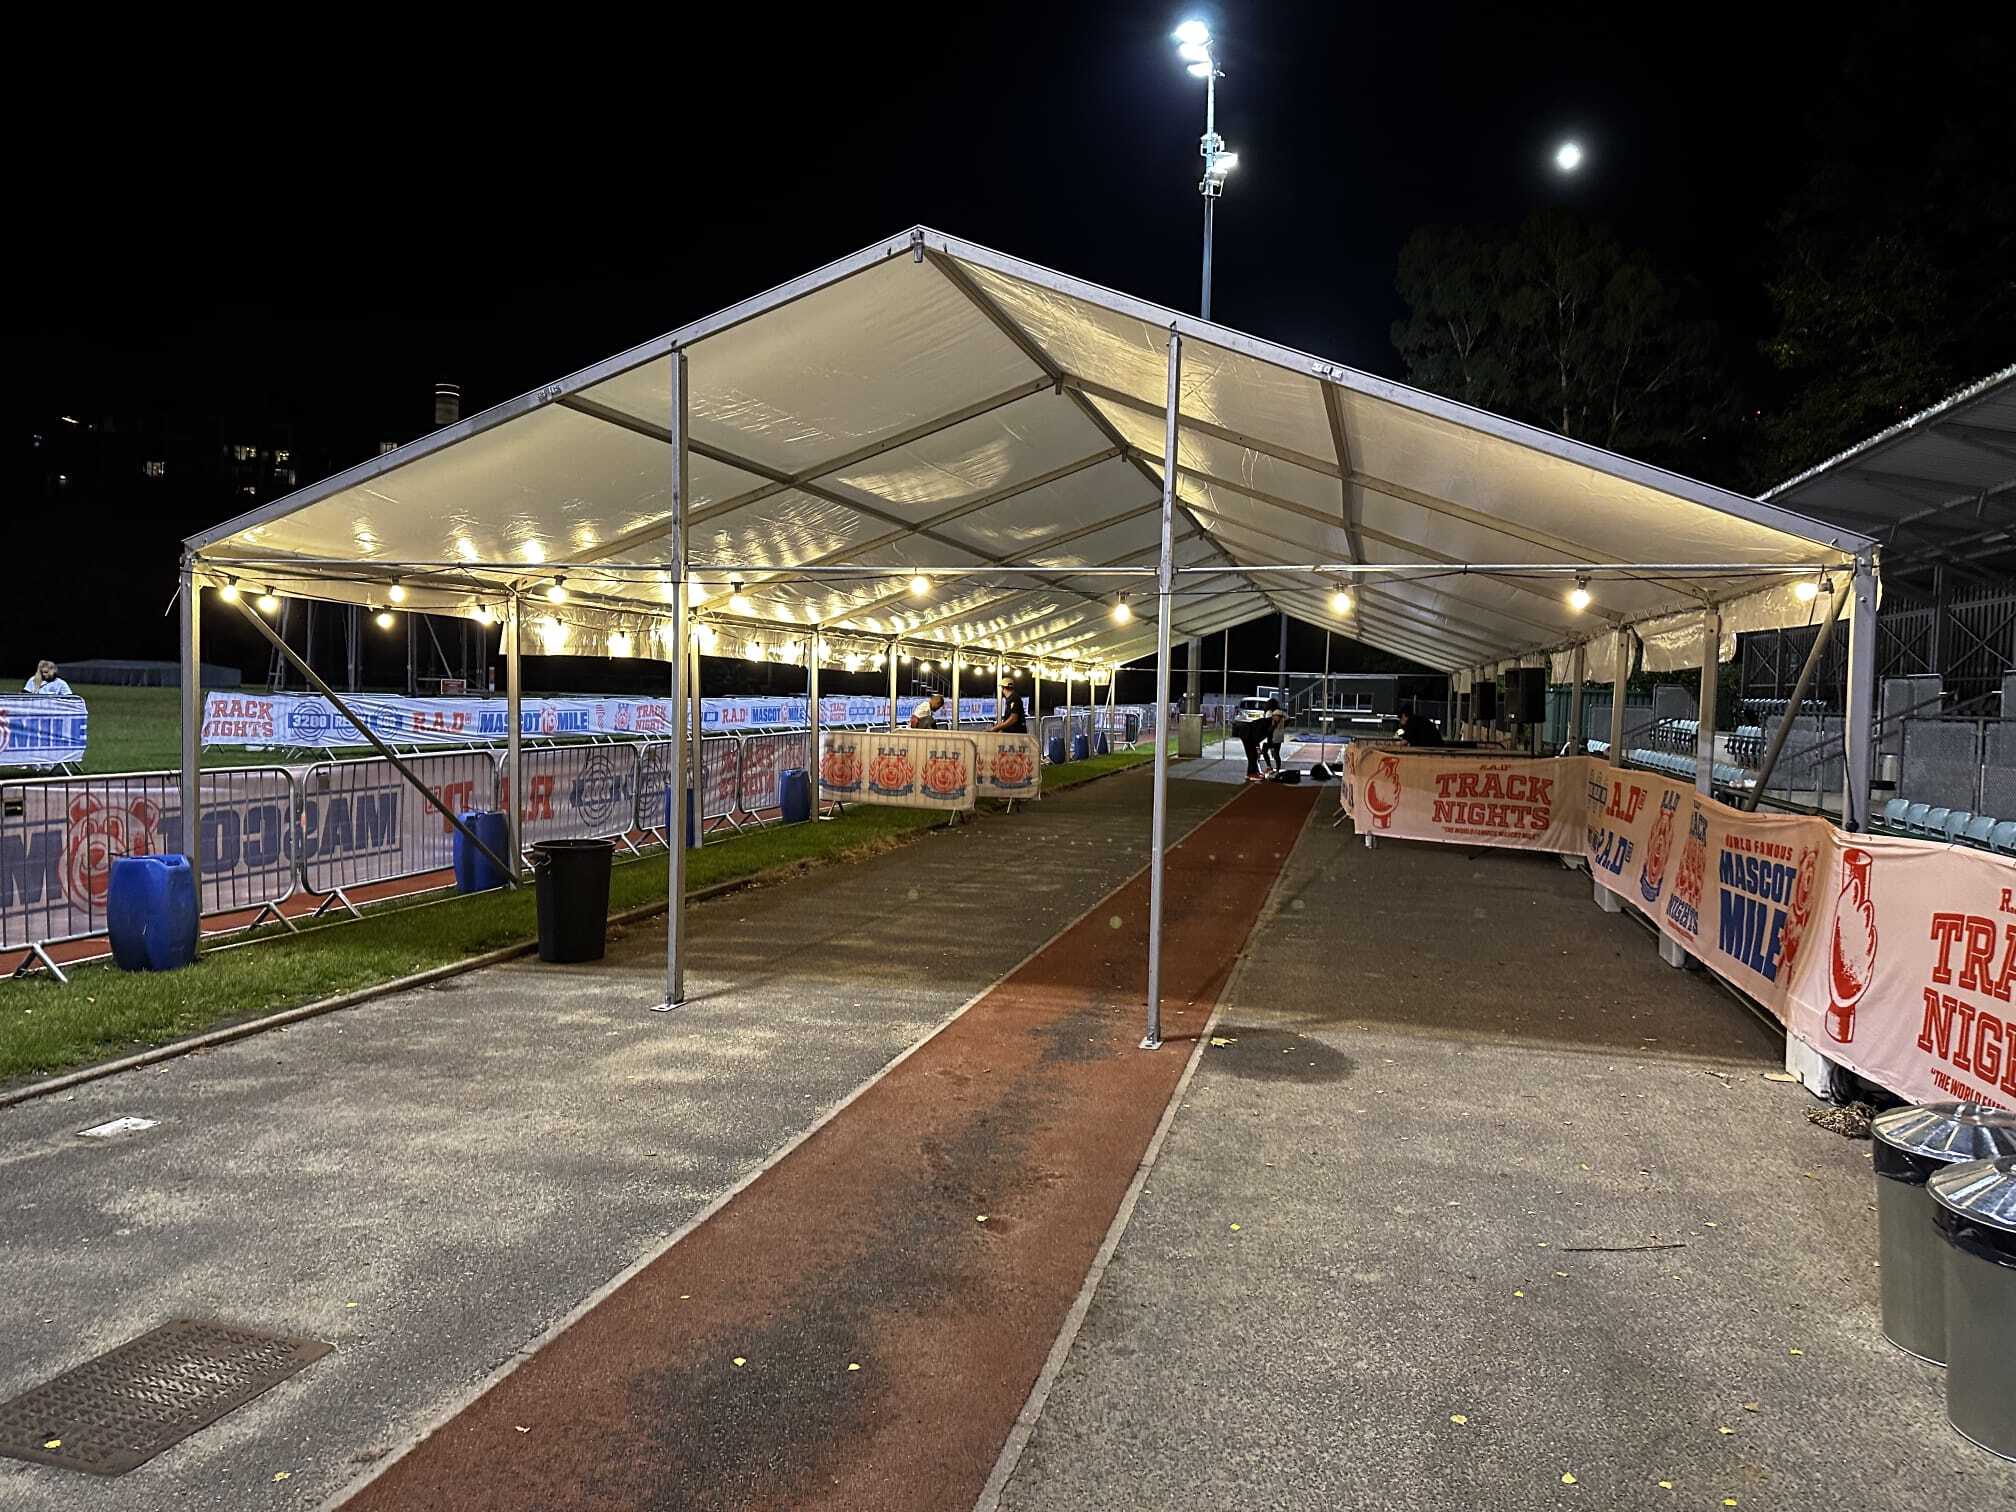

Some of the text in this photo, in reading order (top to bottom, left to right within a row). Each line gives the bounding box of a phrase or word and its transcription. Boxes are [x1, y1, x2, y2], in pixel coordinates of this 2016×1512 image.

[9, 718, 87, 749] MILE
[291, 715, 327, 728] 3200
[479, 712, 542, 734] MAOT
[557, 711, 589, 732] MILE
[1436, 772, 1554, 806] TRACK
[1432, 800, 1551, 831] NIGHTS
[1754, 839, 1793, 861] FAMOUS
[1719, 849, 1797, 906] MASCOT
[1719, 887, 1788, 983] MILE
